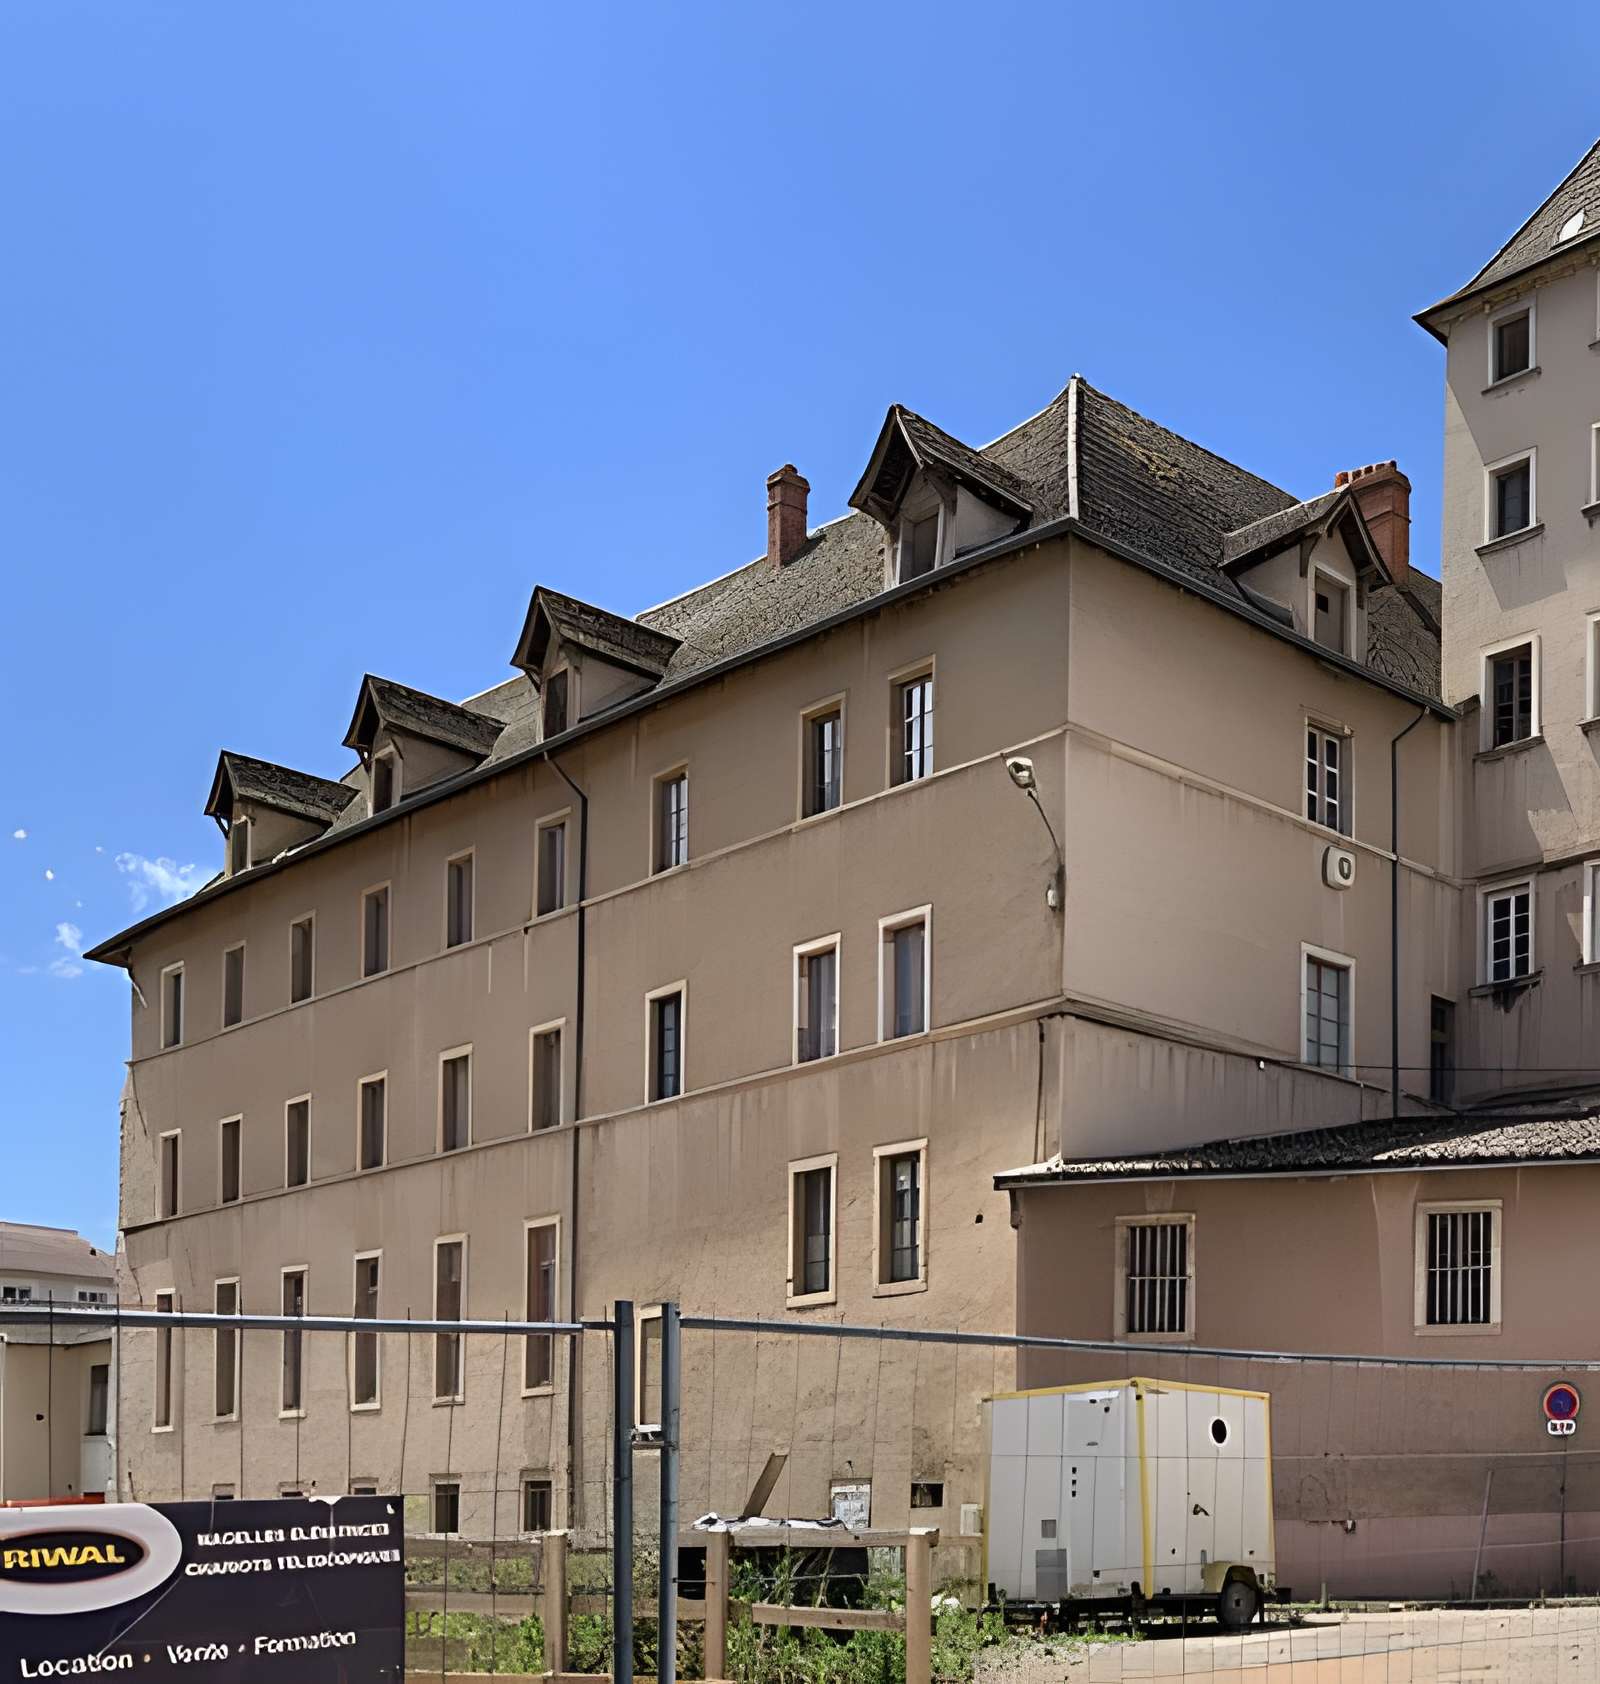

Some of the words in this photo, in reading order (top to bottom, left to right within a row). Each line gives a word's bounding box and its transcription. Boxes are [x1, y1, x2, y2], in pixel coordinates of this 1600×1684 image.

[3, 1544, 126, 1569] RIWAL
[20, 1653, 134, 1679] Location
[254, 1631, 356, 1656] Formation
